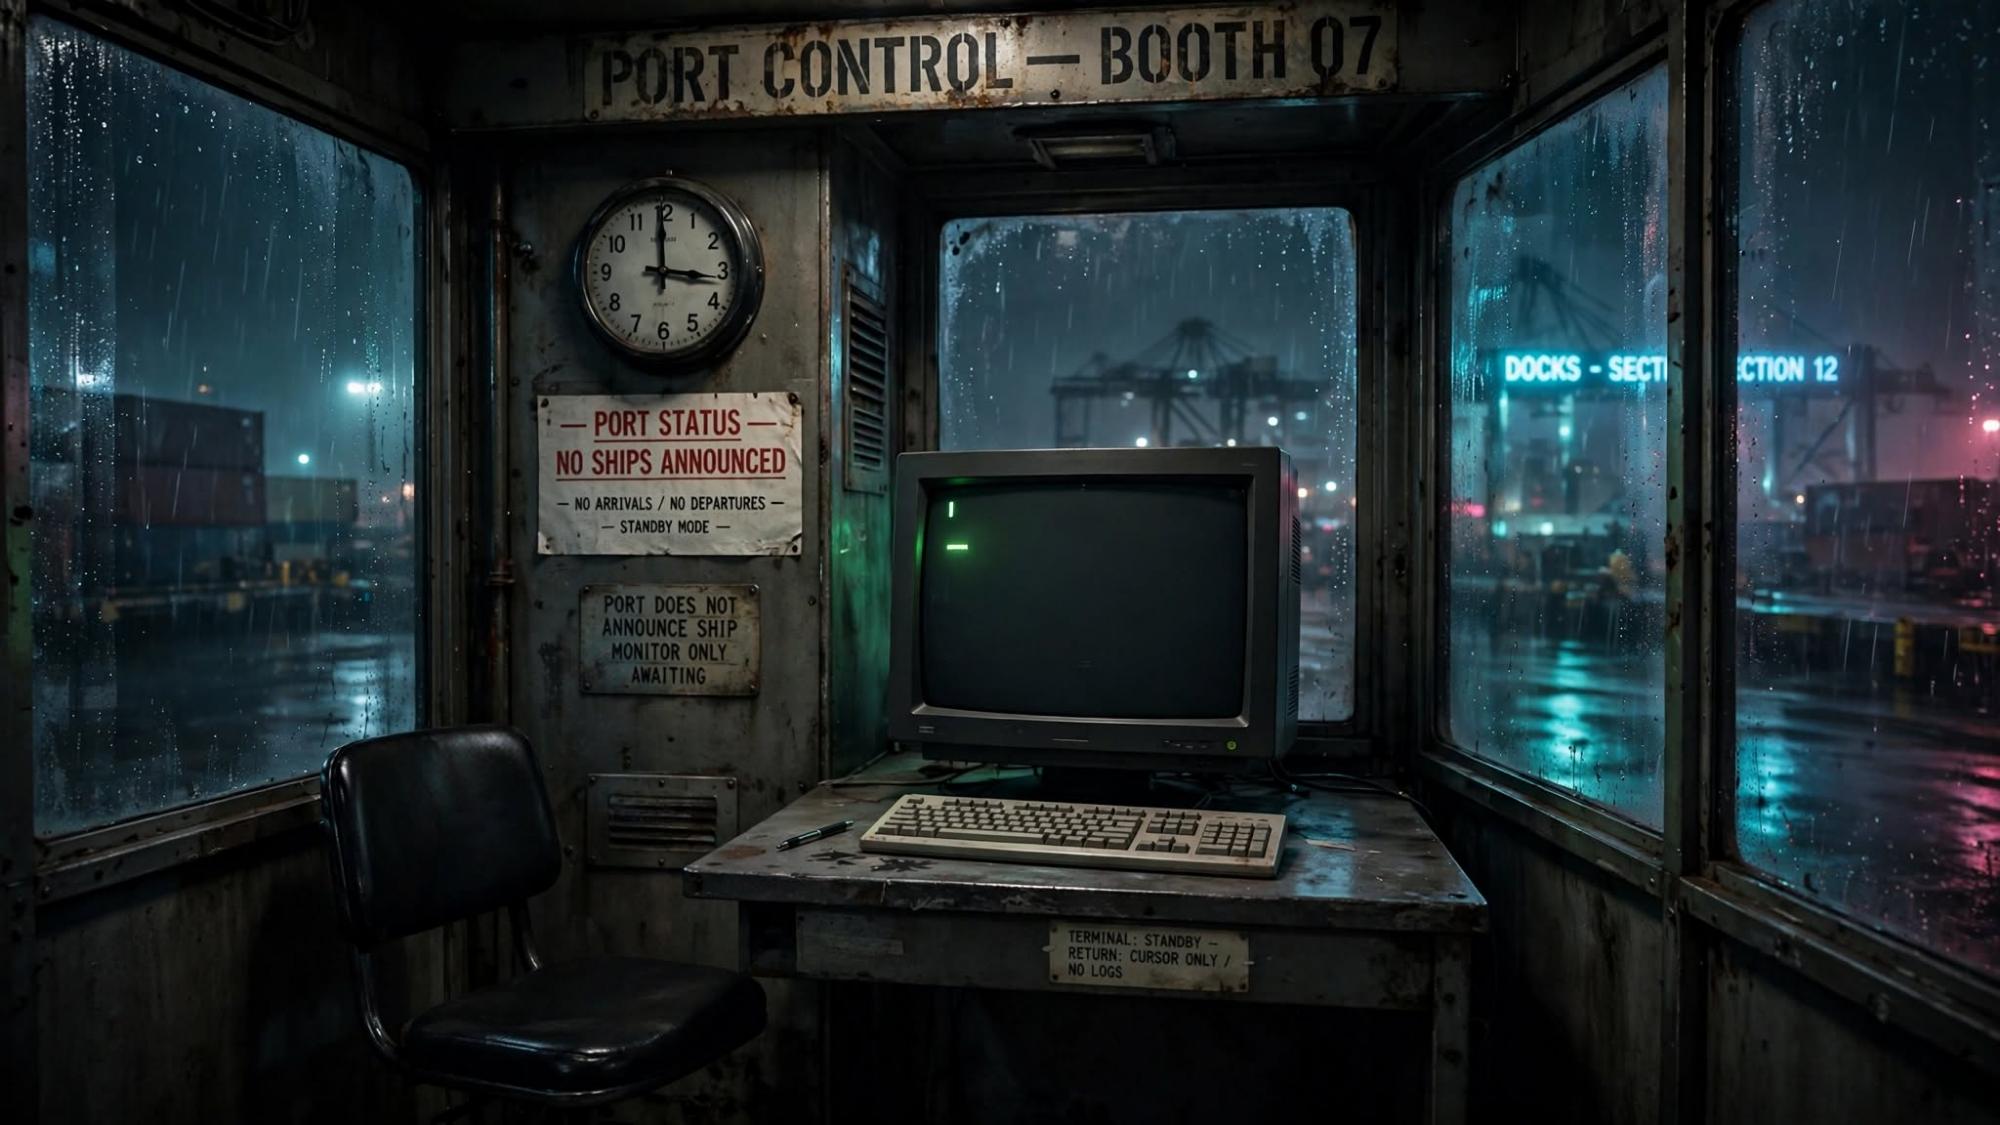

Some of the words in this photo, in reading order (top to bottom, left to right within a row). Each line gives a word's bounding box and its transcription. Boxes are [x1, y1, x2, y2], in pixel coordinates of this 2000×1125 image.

[601, 44, 740, 106] PORT
[763, 32, 1014, 99] CONTROL
[1101, 20, 1286, 85] BOOTH
[1311, 15, 1381, 77] 07
[630, 213, 642, 231] 11
[655, 204, 673, 222] 12
[690, 213, 695, 229] 1
[609, 235, 626, 253] 10
[708, 232, 719, 250] 2
[601, 263, 612, 281] 9
[717, 261, 729, 280] 3
[609, 293, 621, 312] 8
[708, 292, 720, 310] 4
[631, 314, 642, 333] 7
[657, 322, 670, 340] 6
[687, 313, 699, 332] 5
[1504, 355, 1582, 382] DOCKS
[1813, 355, 1839, 382] 12
[594, 410, 650, 436] PORT
[659, 409, 741, 436] STATUS
[556, 450, 583, 475] NO
[592, 449, 652, 475] SHIPS
[661, 447, 786, 475] ANNOUNCED
[574, 497, 590, 511] NO
[595, 496, 652, 511] ARRIVALS
[670, 496, 686, 511] NO
[691, 496, 766, 511] DEPARTURES
[620, 520, 673, 534] STANDBY
[678, 520, 710, 534] MODE
[604, 595, 645, 614] PORT
[655, 596, 696, 615] DOES
[706, 596, 737, 614] NOT
[602, 618, 688, 638] ANNOUNCE
[697, 619, 738, 638] SHIP
[611, 643, 680, 661] MONITOR
[688, 643, 727, 661] ONLY
[631, 666, 706, 685] AWAITING
[1068, 930, 1138, 946] TERMINAL:
[1144, 934, 1201, 949] STANDBY
[1068, 947, 1123, 962] RETURN:
[1130, 949, 1179, 966] CURSOR
[1185, 953, 1218, 967] ONLY
[1068, 963, 1085, 977] NO
[1091, 965, 1123, 979] LOGS
